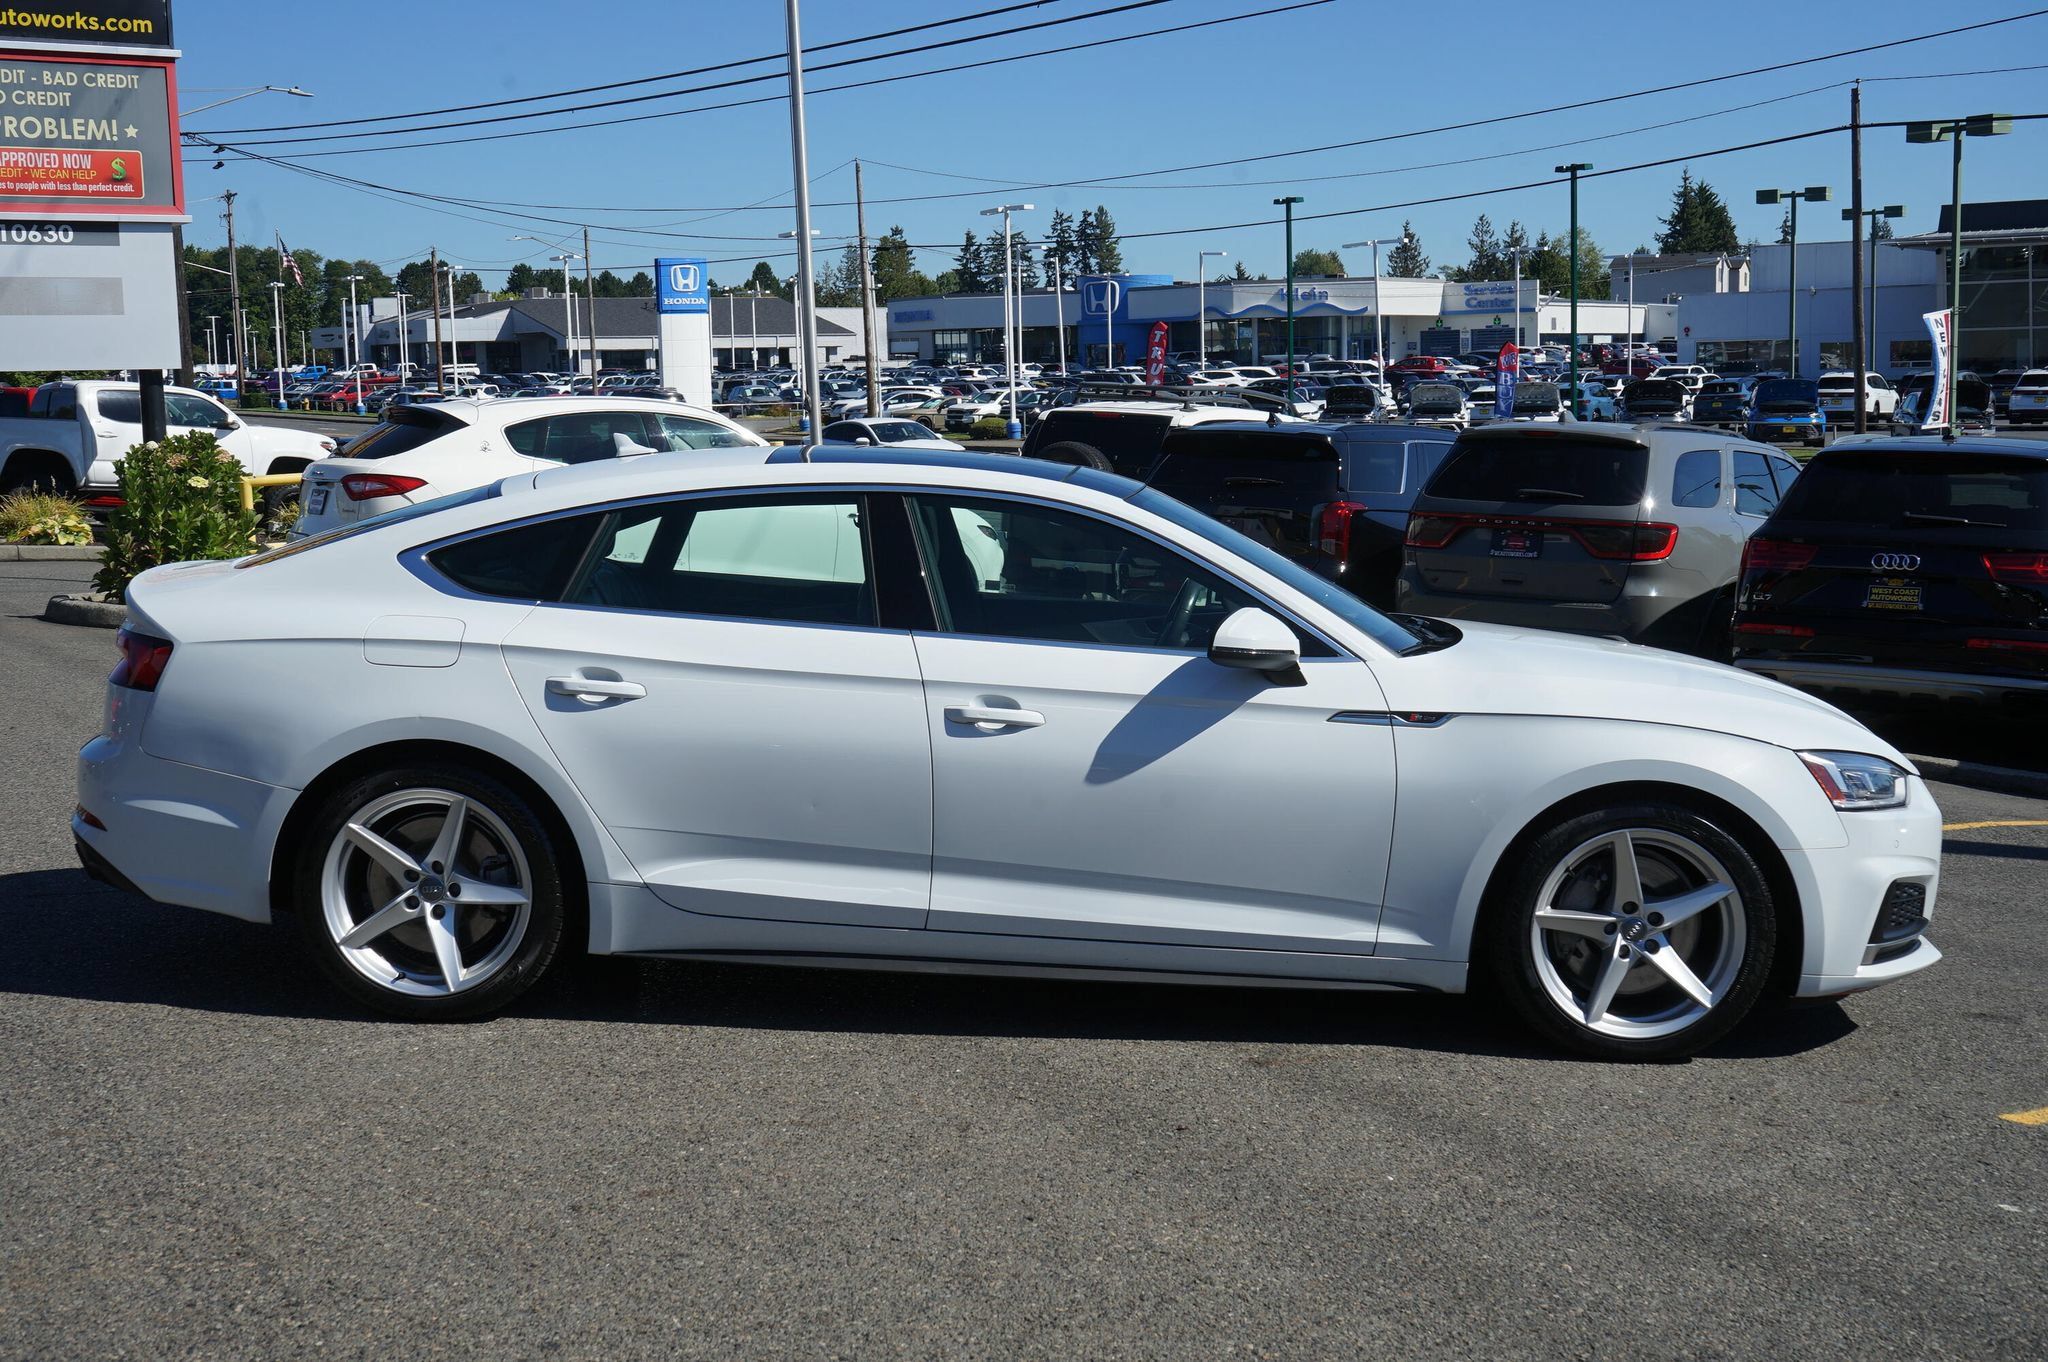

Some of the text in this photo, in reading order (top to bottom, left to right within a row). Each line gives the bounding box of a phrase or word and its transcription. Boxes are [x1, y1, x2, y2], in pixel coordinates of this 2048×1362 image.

[43, 70, 78, 86] BAD
[83, 72, 139, 89] CREDIT
[12, 90, 72, 106] CREDIT
[0, 115, 118, 142] ROBLEM!
[0, 151, 92, 169] PPROVED NOW
[30, 168, 47, 179] WE
[48, 169, 70, 179] CAN
[71, 170, 97, 180] HELP
[7, 181, 14, 189] to
[15, 181, 39, 192] people
[40, 182, 56, 190] with
[57, 182, 71, 191] less
[72, 183, 88, 191] than
[88, 183, 112, 193] perfect
[0, 224, 74, 243] 10630
[664, 297, 707, 305] HONDA
[1464, 297, 1515, 308] Center
[1870, 594, 1919, 602] AUTOWORKS
[1893, 588, 1920, 596] COAST
